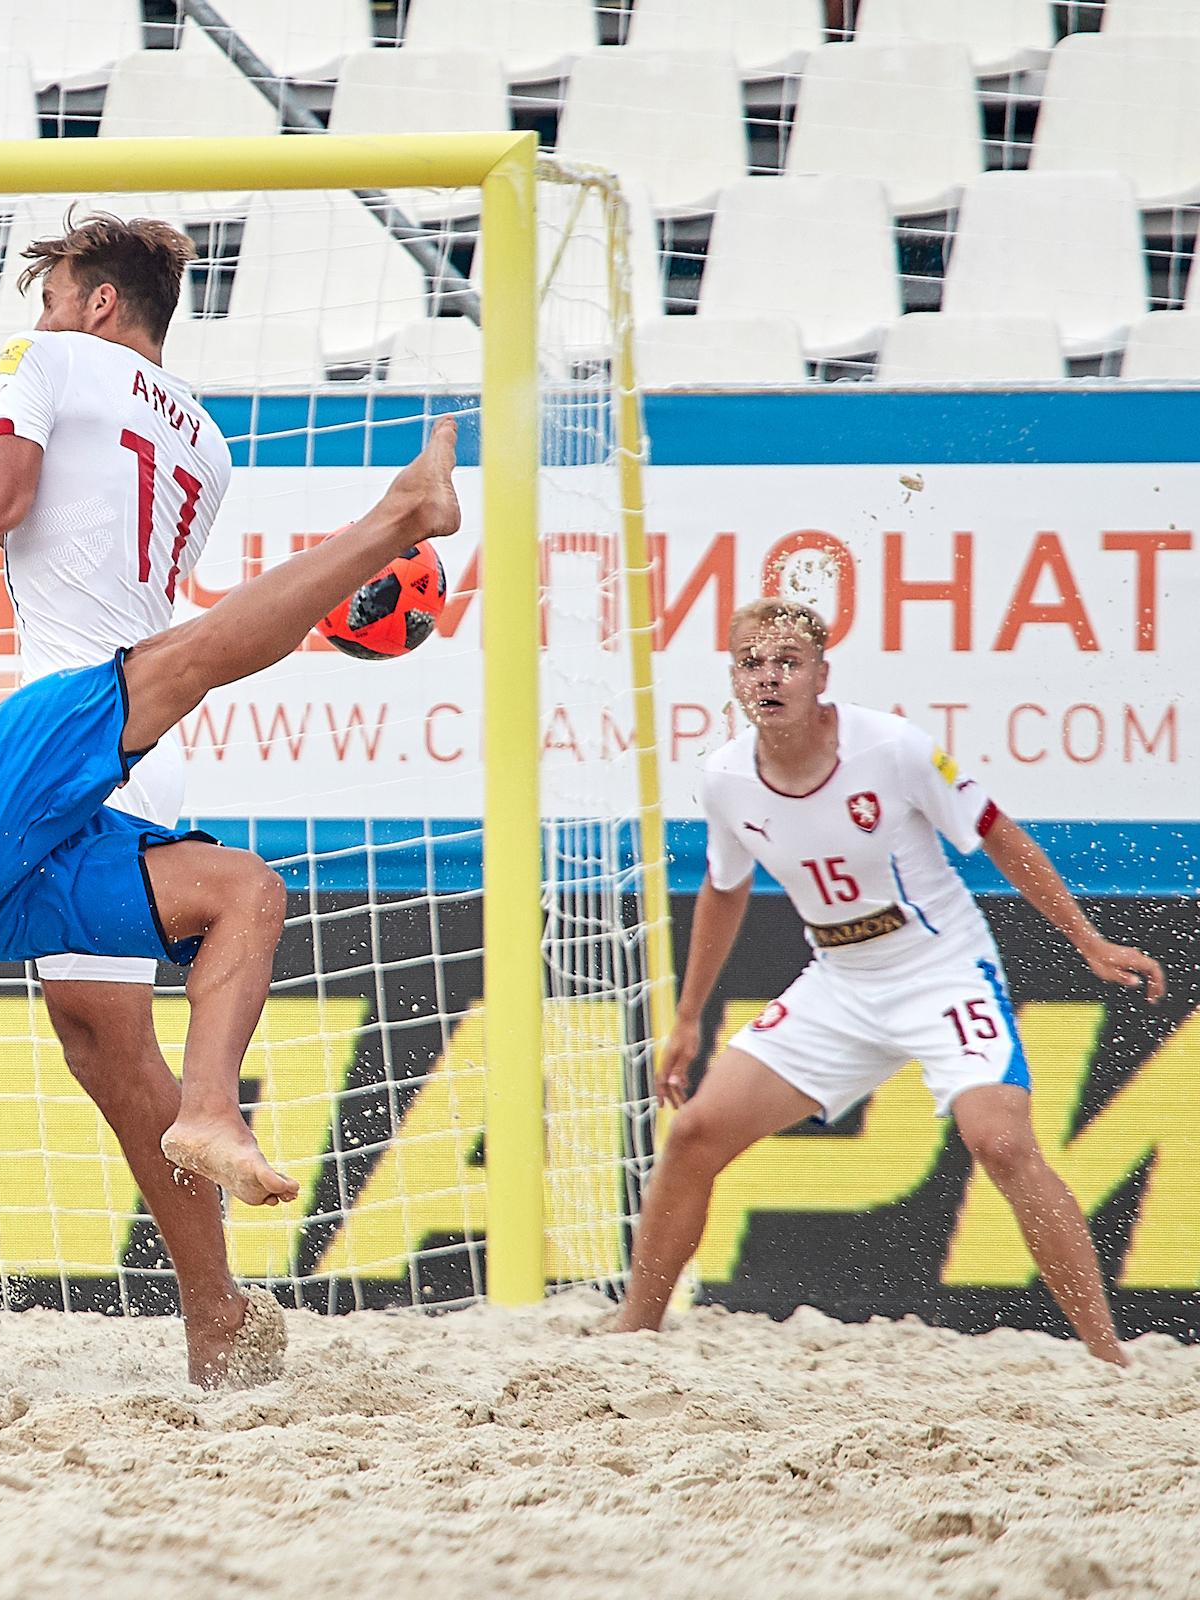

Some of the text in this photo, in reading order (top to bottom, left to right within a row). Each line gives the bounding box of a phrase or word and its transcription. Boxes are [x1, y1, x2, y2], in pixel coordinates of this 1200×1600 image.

[119, 428, 203, 605] 17
[801, 856, 861, 905] 15
[942, 998, 998, 1046] 15
